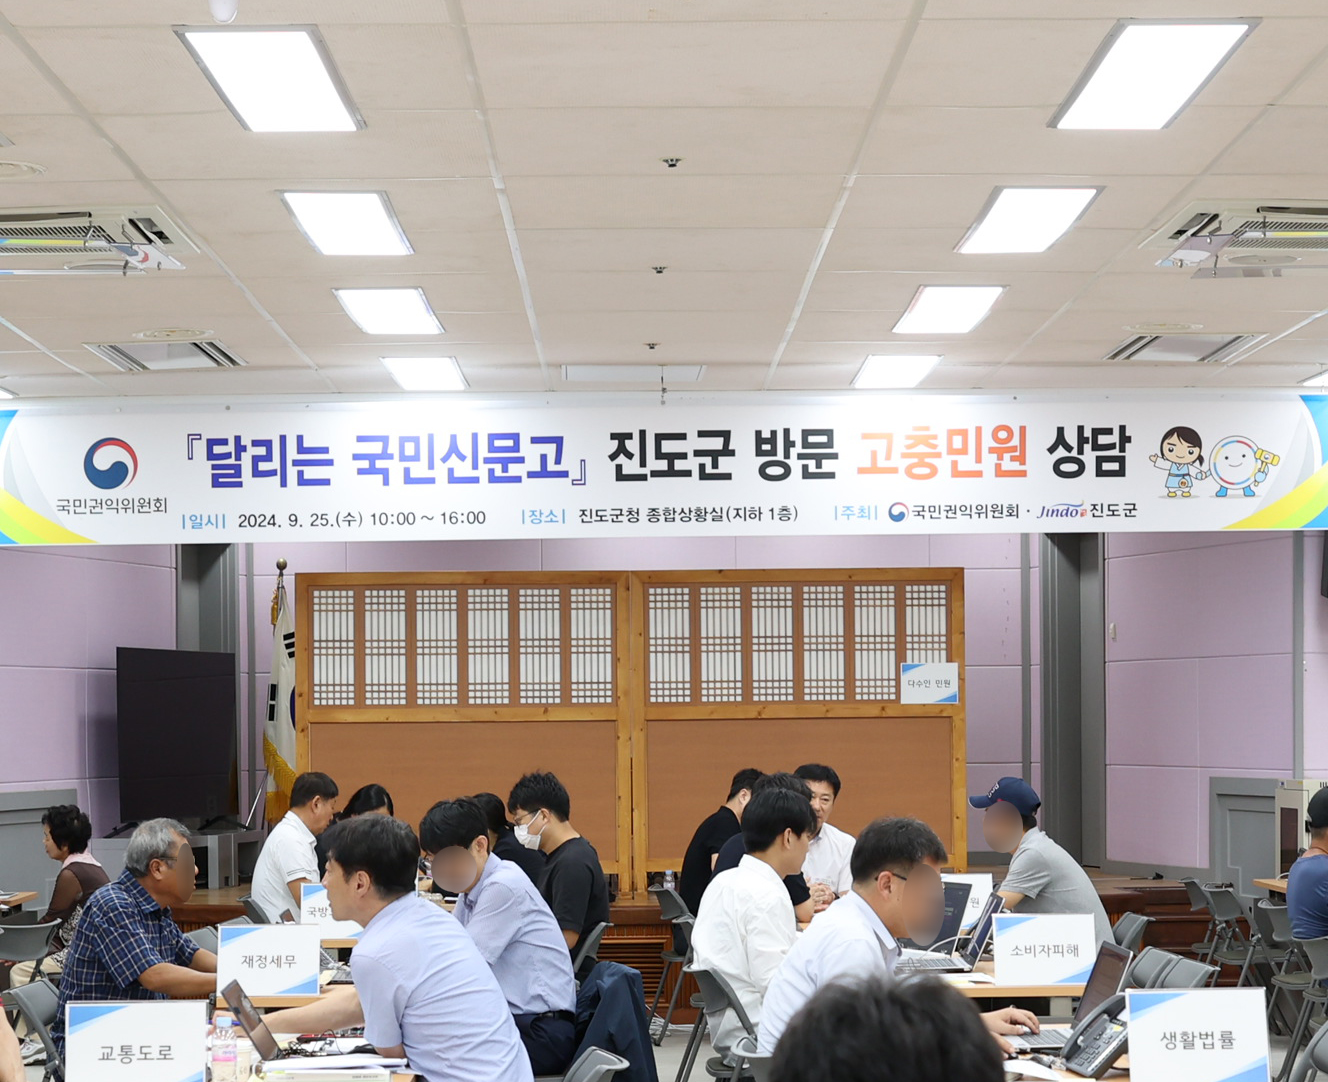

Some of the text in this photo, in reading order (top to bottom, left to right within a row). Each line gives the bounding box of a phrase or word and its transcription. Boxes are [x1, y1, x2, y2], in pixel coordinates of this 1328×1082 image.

[608, 428, 736, 482] 진도군
[754, 427, 839, 482] 방문
[857, 424, 1028, 481] 고충민원
[1046, 424, 1132, 479] 상담
[56, 496, 168, 515] 국민권익위원회
[911, 502, 1020, 520] 국민권익위원회
[1037, 501, 1081, 519] Jindo
[1089, 502, 1138, 519] 진도군
[237, 513, 283, 529] 2024.
[288, 512, 304, 528] 9.
[370, 511, 417, 526] 10:00
[440, 509, 487, 526] 16:00
[578, 507, 641, 524] 진도군청
[907, 679, 951, 689] 다수인 민원
[307, 906, 333, 918] 국방
[1010, 943, 1079, 959] 소비자피해
[241, 954, 297, 969] 재정세무
[1159, 1030, 1237, 1051] 생활법률
[97, 1044, 175, 1065] 교통도로
